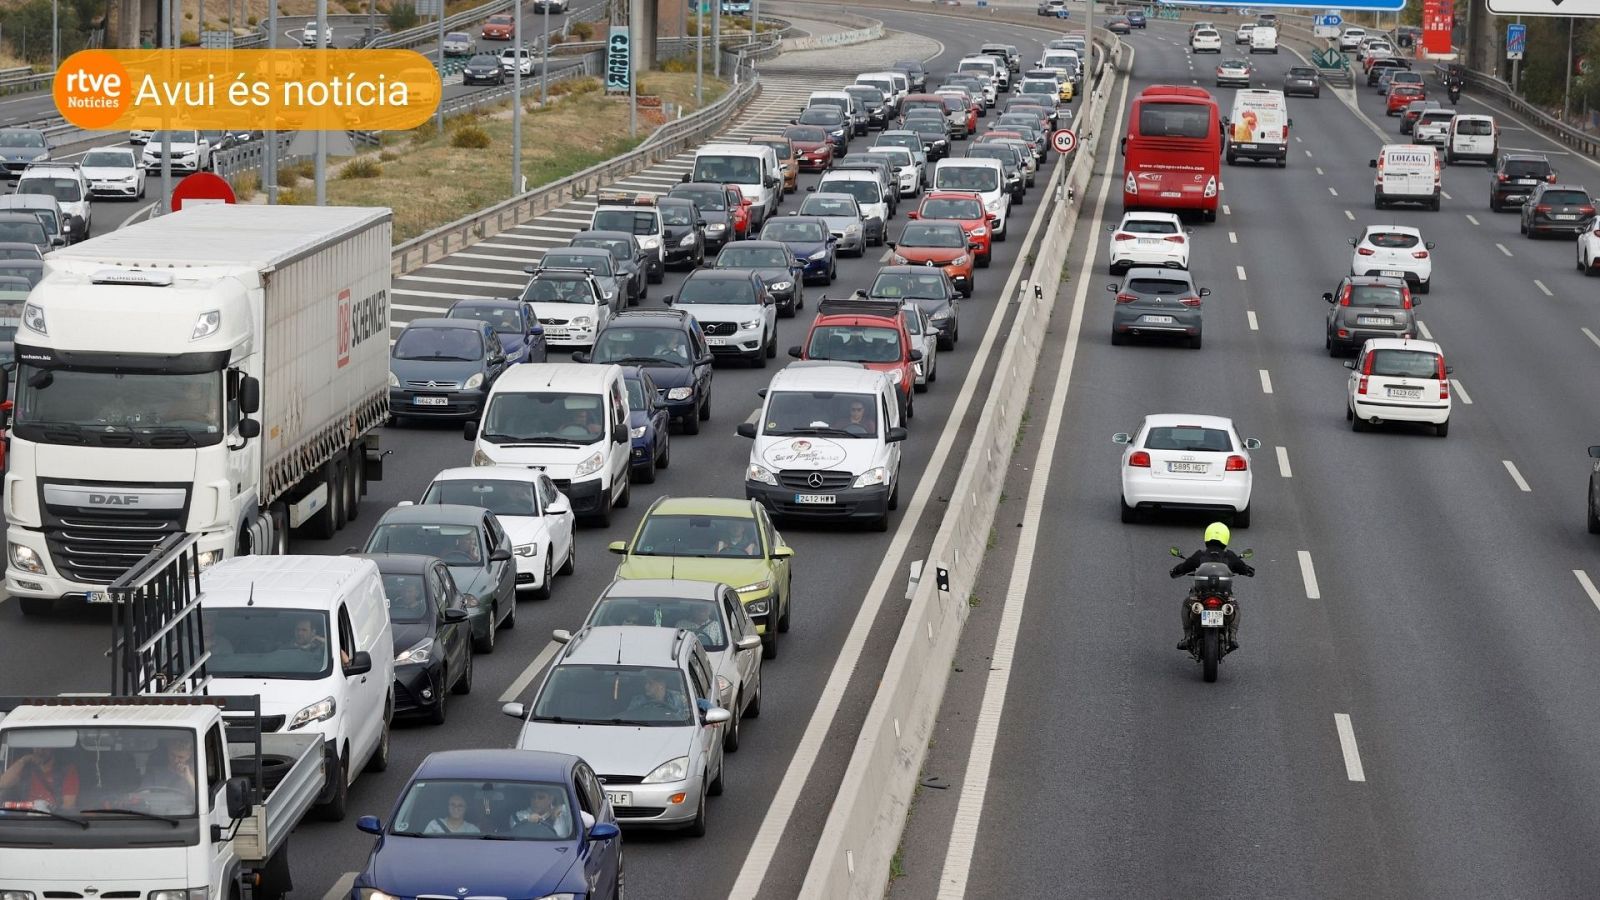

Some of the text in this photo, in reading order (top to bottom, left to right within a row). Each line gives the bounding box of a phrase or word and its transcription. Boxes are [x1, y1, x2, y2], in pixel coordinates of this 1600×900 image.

[1329, 16, 1338, 24] 10
[1058, 137, 1070, 145] 90
[1391, 154, 1427, 162] LOIZAGA
[351, 289, 387, 348] SCHENKER
[88, 494, 139, 505] DAF
[91, 593, 103, 601] SV
